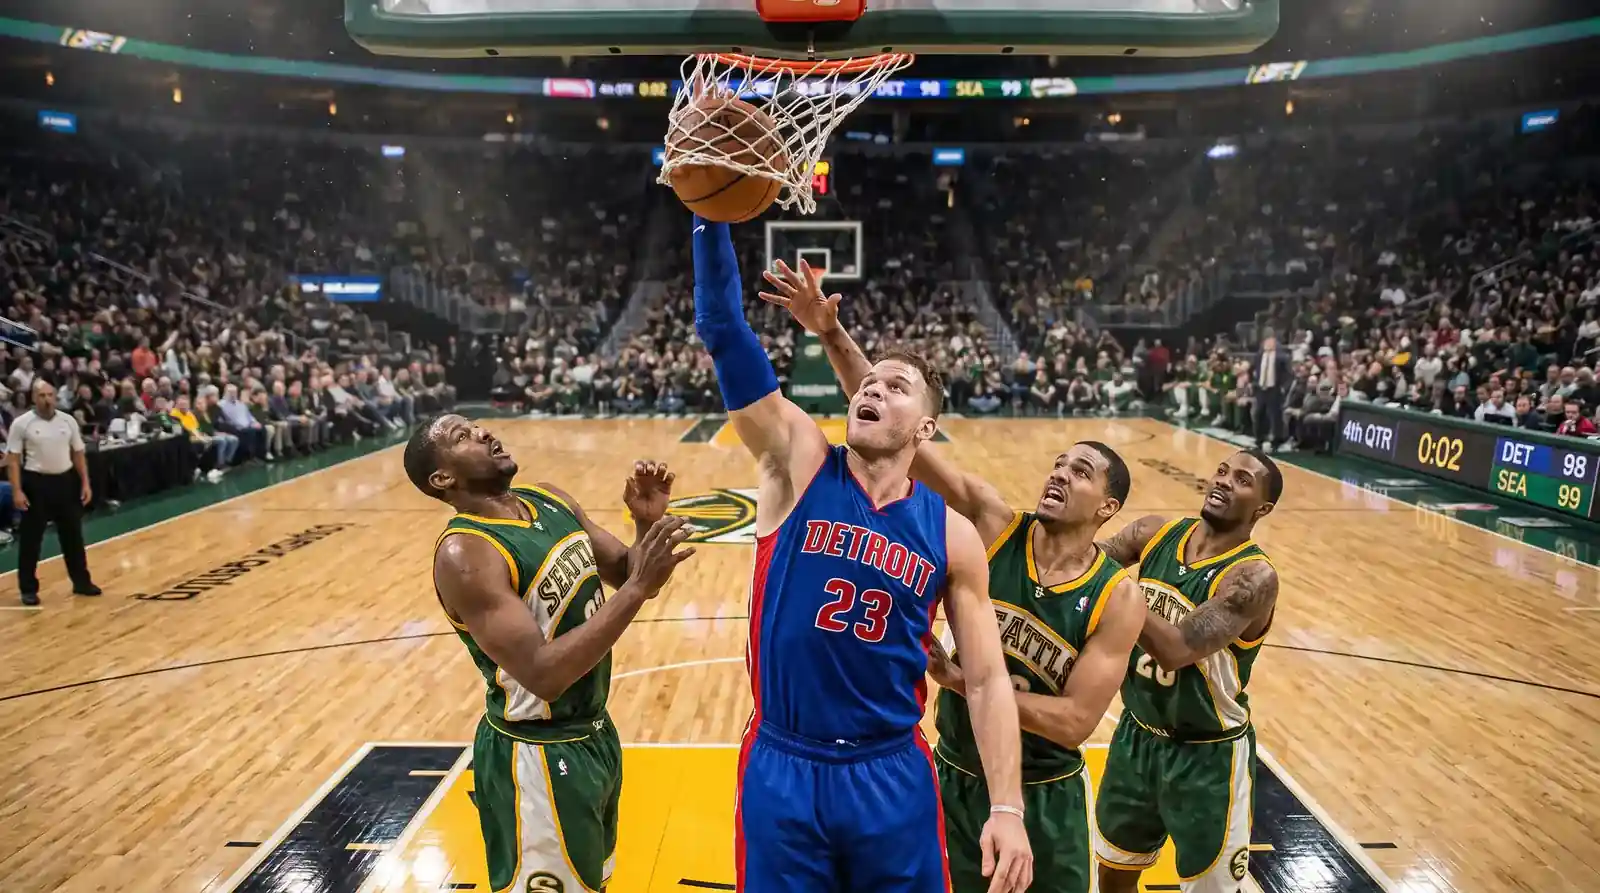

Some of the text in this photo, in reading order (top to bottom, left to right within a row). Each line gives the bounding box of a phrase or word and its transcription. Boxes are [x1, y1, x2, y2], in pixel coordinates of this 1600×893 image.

[956, 81, 984, 97] SEA
[1000, 80, 1021, 97] 99
[1343, 420, 1392, 451] 4th QTR
[1418, 432, 1463, 471] 0:02
[1501, 441, 1587, 478] DET 98
[1497, 469, 1581, 509] SEA 99
[801, 520, 936, 597] DETROIT
[815, 578, 893, 642] 23
